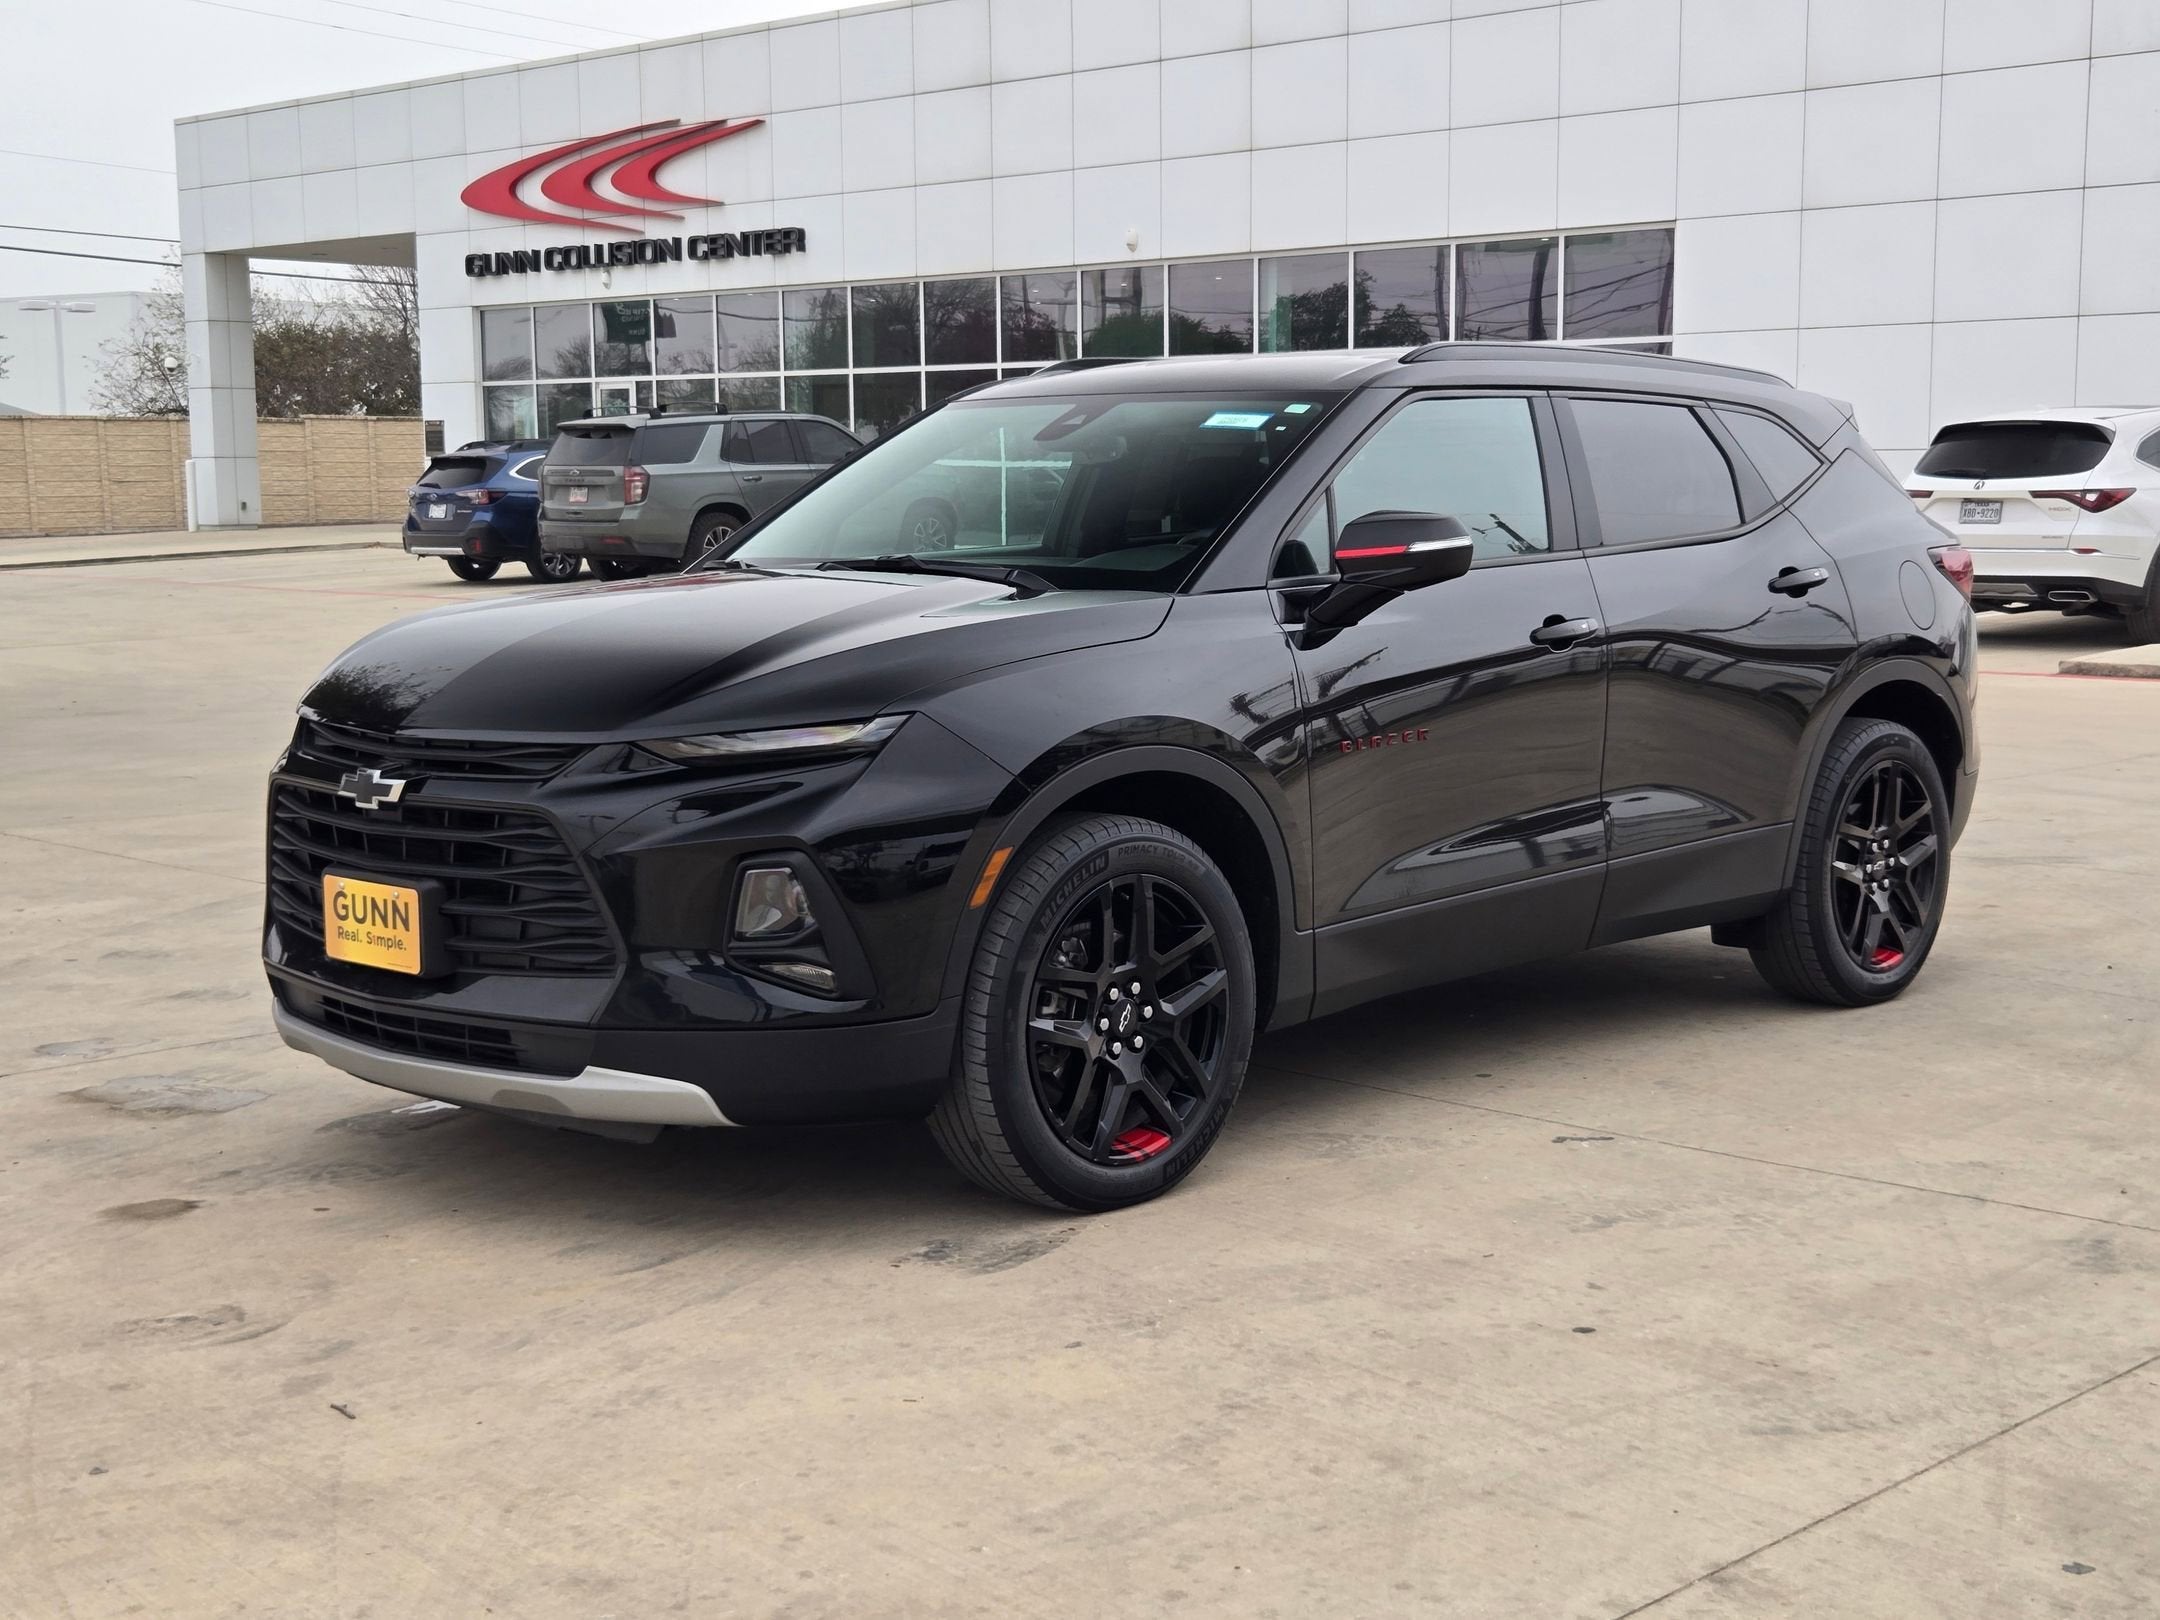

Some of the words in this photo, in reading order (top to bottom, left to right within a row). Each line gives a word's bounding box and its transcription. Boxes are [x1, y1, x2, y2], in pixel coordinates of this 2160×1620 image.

[464, 249, 541, 278] GUNN
[544, 237, 682, 272] COLLISION
[687, 227, 806, 261] CENTER
[1341, 728, 1431, 752] BLAZER
[1118, 844, 1159, 857] PRIMACY
[1039, 854, 1107, 930] MICHELIN
[333, 890, 410, 932] GUNN
[337, 926, 362, 943] Real.
[366, 931, 407, 951] Simple.
